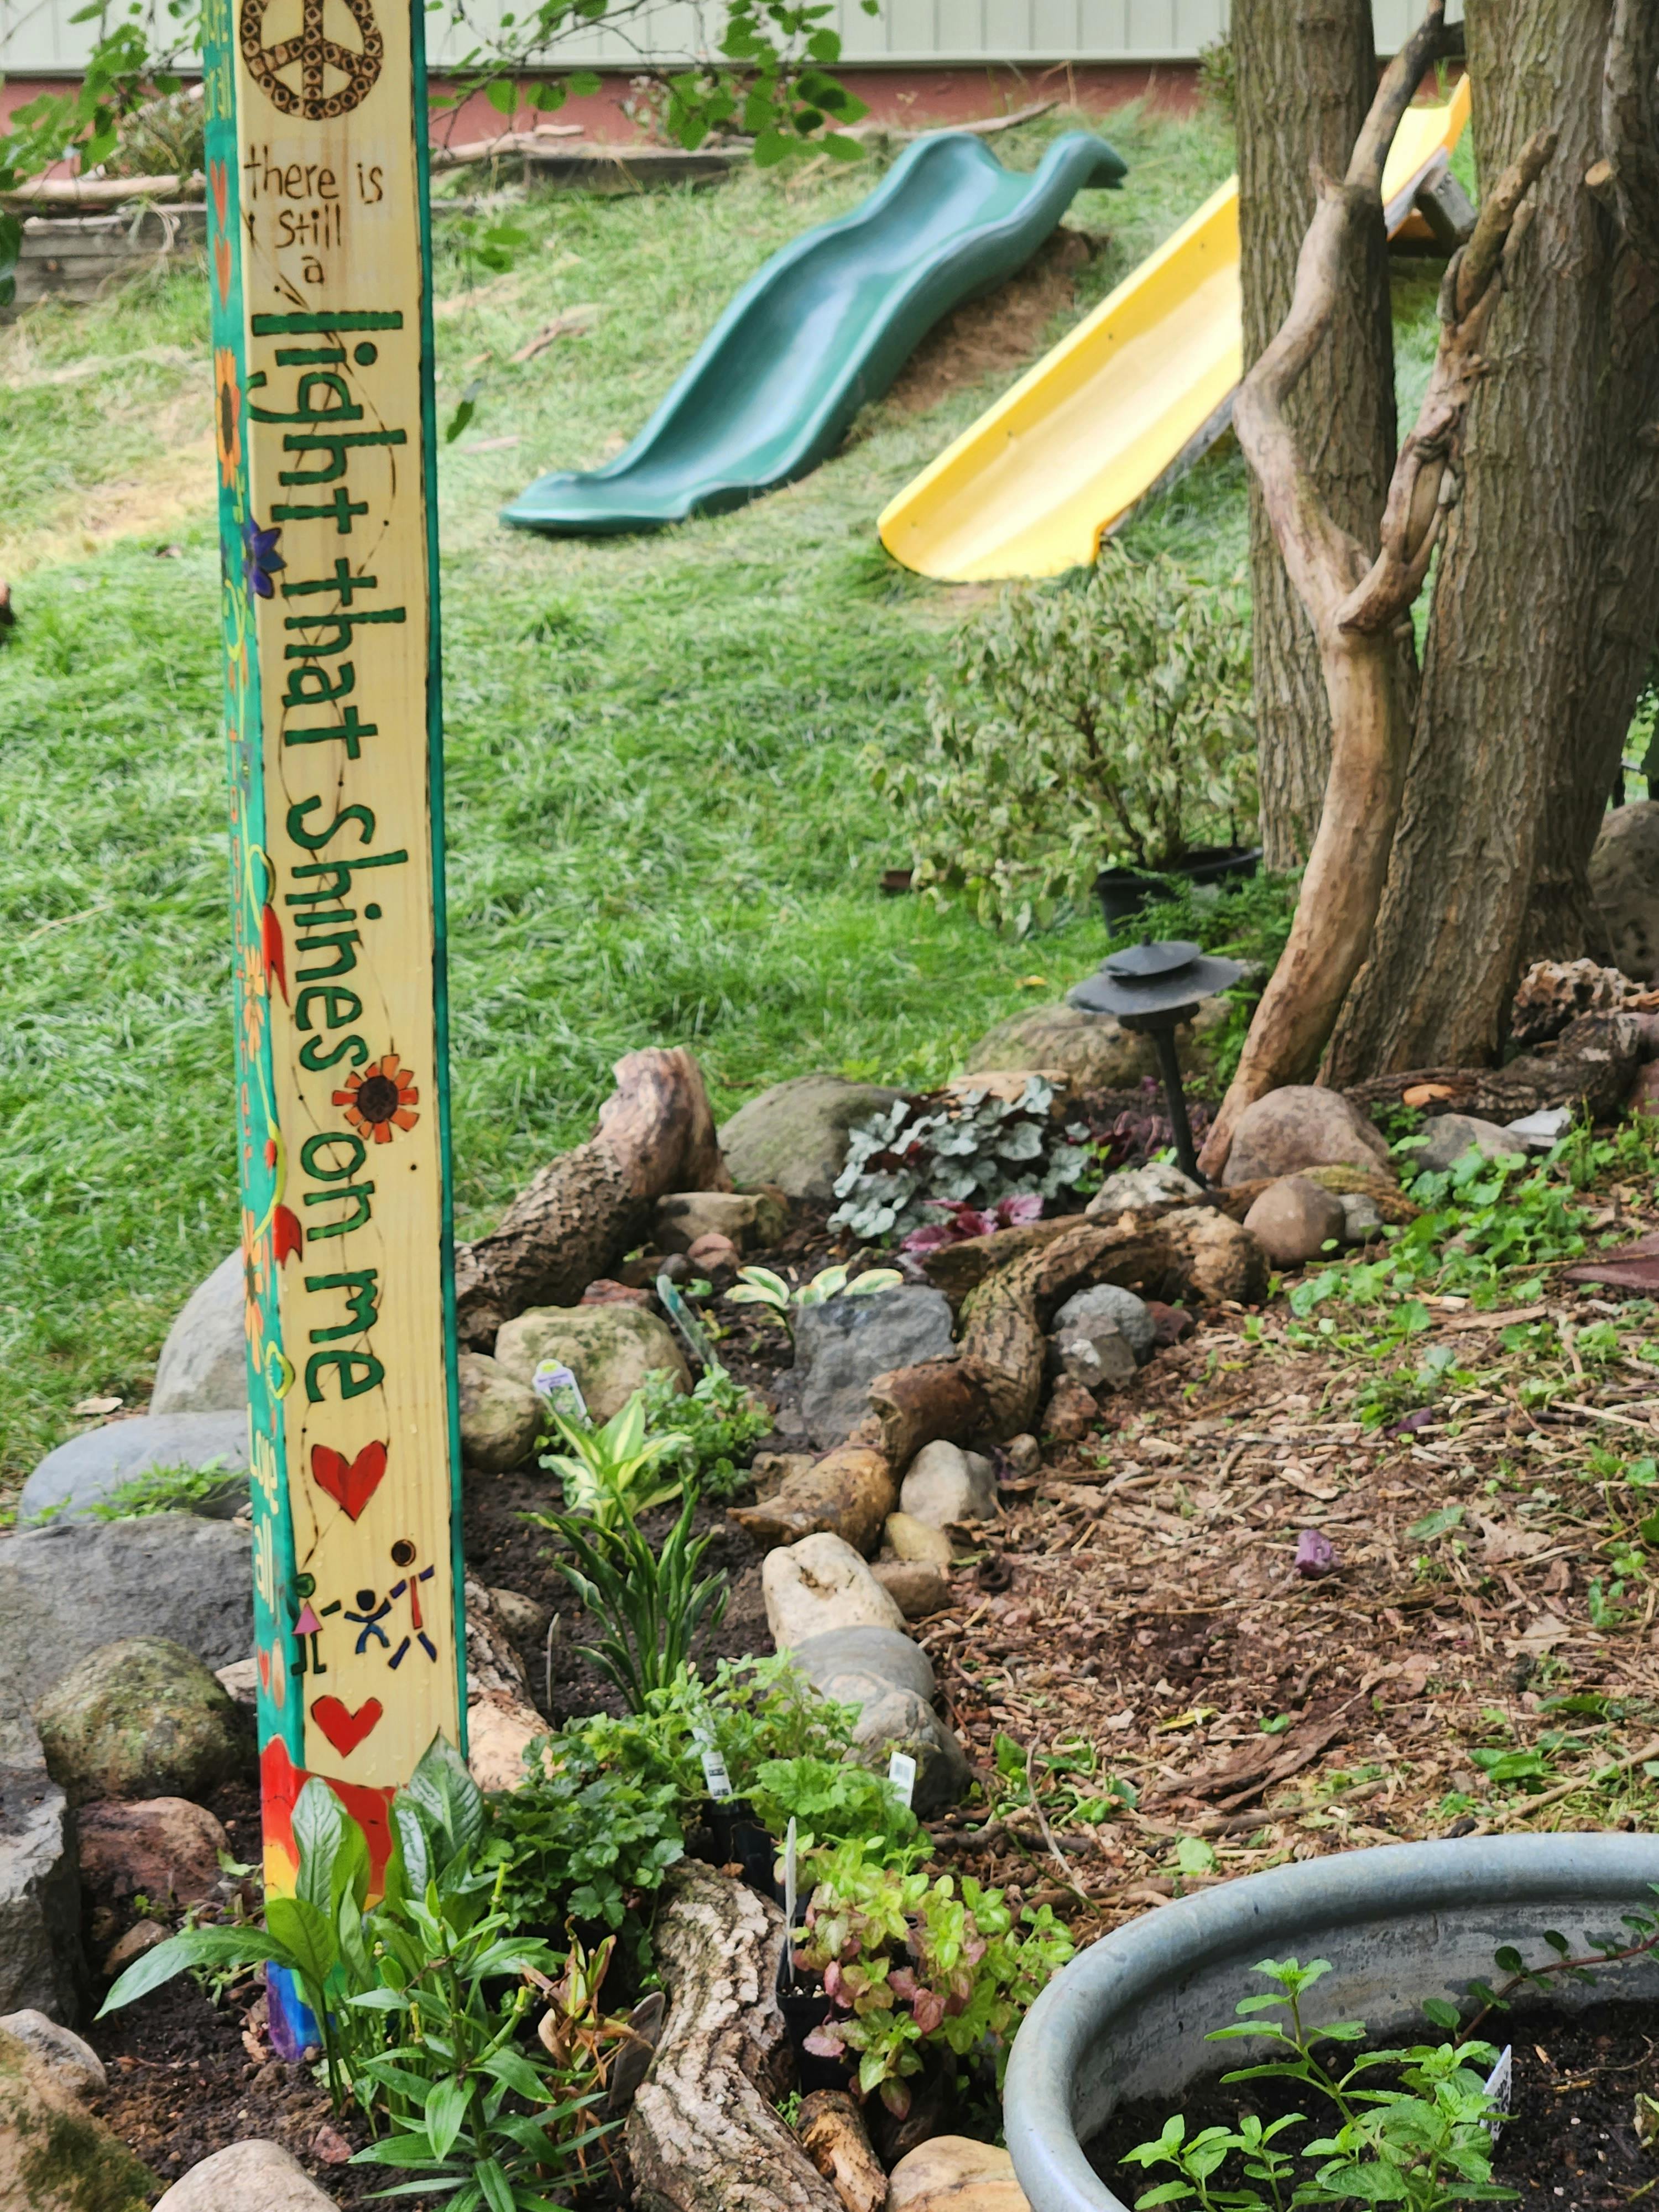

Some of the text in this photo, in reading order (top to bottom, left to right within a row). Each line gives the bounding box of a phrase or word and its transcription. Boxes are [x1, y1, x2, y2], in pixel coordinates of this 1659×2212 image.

[244, 144, 384, 205] there is
[301, 255, 325, 285] a
[247, 311, 407, 534] light
[281, 557, 406, 760] that
[300, 1131, 375, 1242] on
[304, 1268, 385, 1404] me
